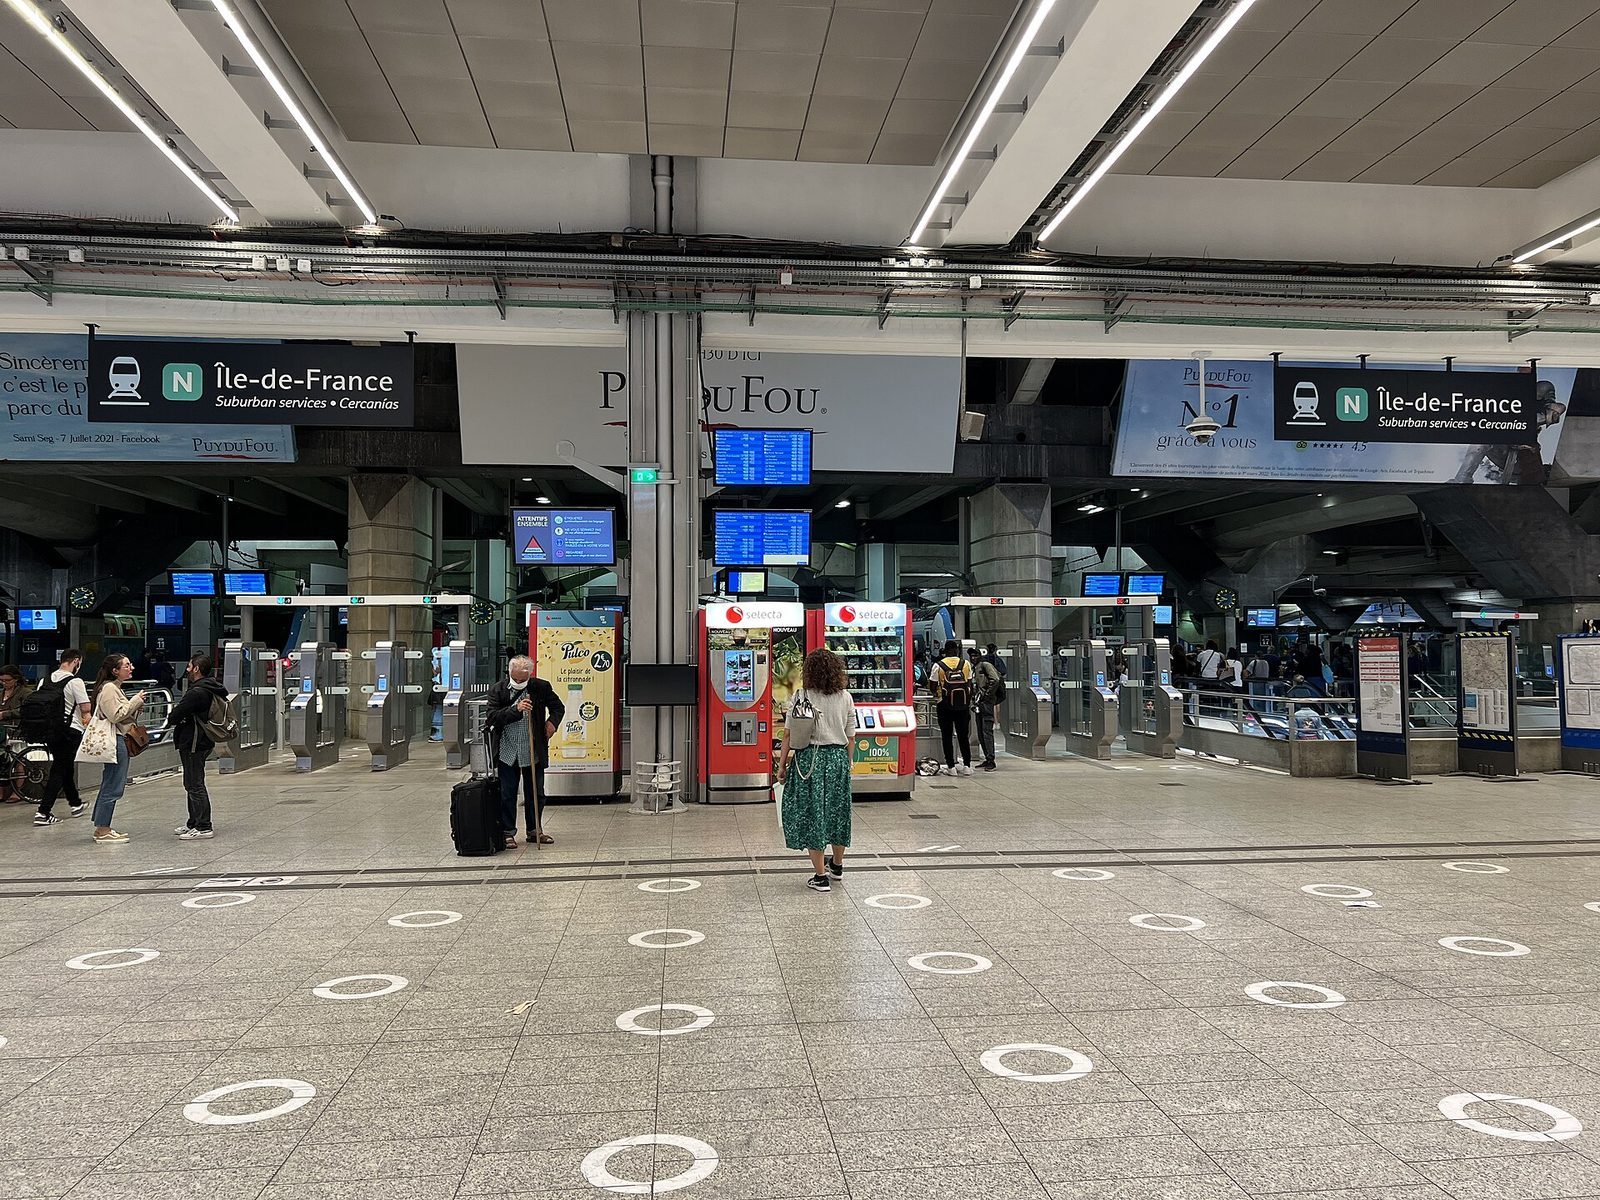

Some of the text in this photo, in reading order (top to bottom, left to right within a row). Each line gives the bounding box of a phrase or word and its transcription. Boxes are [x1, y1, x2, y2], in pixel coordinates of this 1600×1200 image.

[214, 362, 393, 391] Île-de-France
[1184, 367, 1251, 382] PUDUFOU
[3, 376, 47, 393] c'est
[52, 377, 69, 393] le
[172, 371, 192, 393] N
[215, 395, 399, 410] Suburban services Cercanías
[1344, 395, 1360, 414] N
[1376, 387, 1522, 413] Île-de-France
[8, 400, 82, 420] parc du
[1378, 417, 1527, 430] Suburban services Cercanías
[69, 434, 92, 443] Juillet
[95, 434, 114, 443] 2021
[121, 435, 160, 443] Facebook
[1221, 437, 1257, 448] vous
[746, 611, 782, 619] selecta
[859, 611, 894, 619] selecta
[26, 643, 36, 651] 10
[561, 642, 590, 660] Pulco
[568, 668, 583, 676] plaisir
[566, 721, 582, 732] Pulco
[869, 748, 889, 757] 100%
